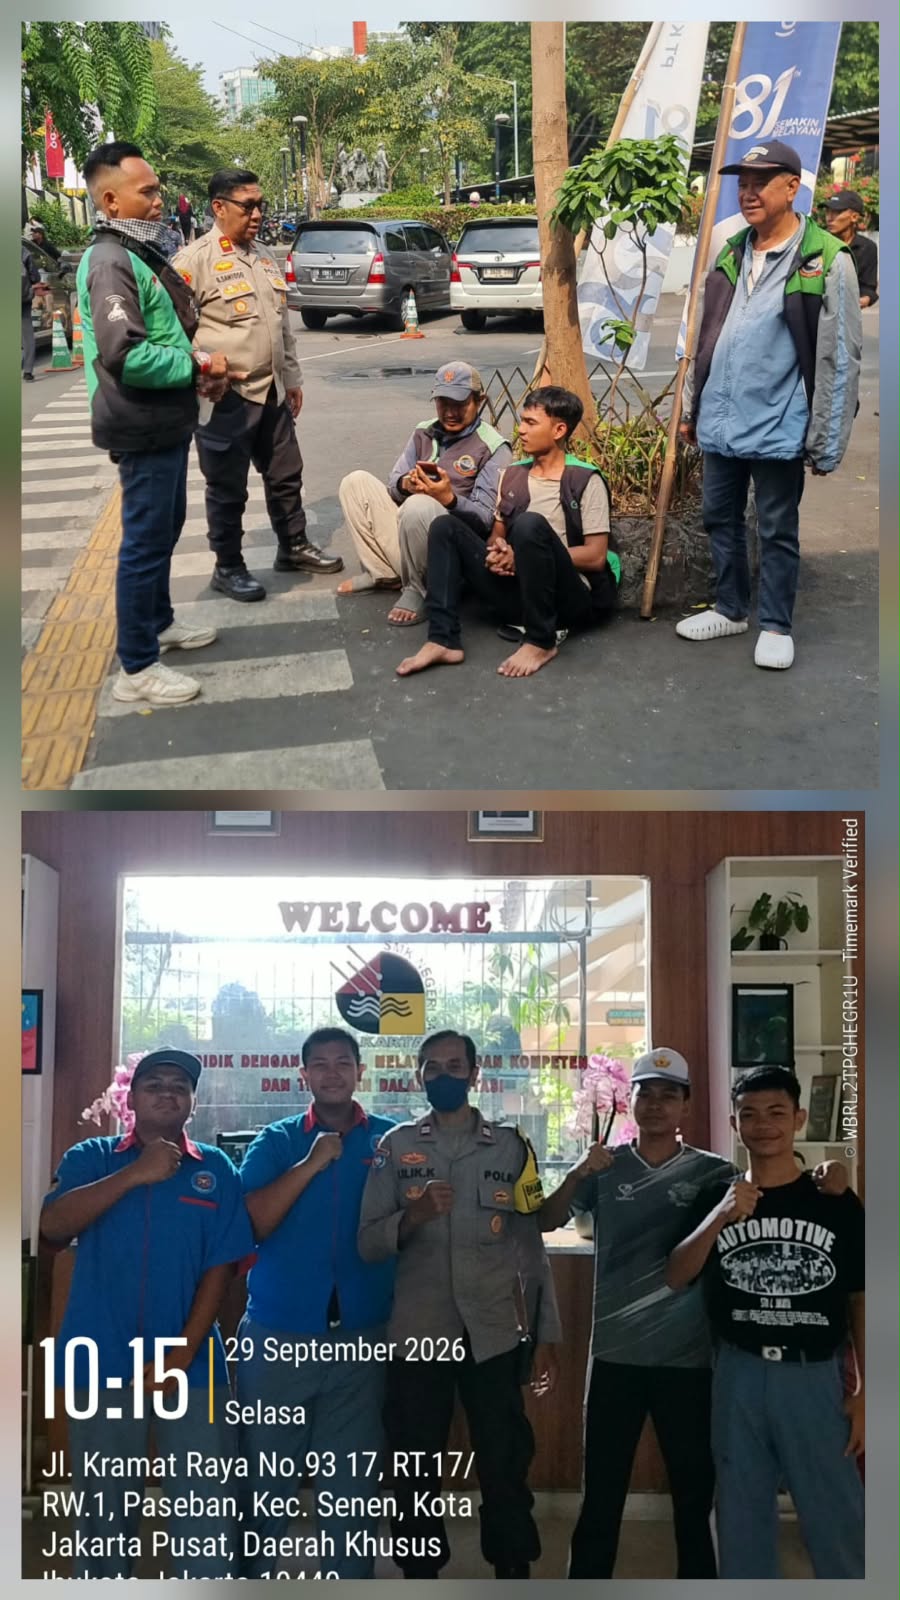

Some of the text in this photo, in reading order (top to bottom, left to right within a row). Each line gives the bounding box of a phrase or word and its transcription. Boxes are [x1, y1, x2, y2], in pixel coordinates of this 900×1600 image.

[728, 65, 797, 140] 81
[278, 900, 492, 934] WELCOME
[360, 1036, 424, 1048] KARTA
[241, 1054, 300, 1068] DENGAN
[511, 1055, 588, 1069] KOMPETEN
[261, 1078, 291, 1092] DAN
[716, 1217, 837, 1253] AUTOMOTIVE
